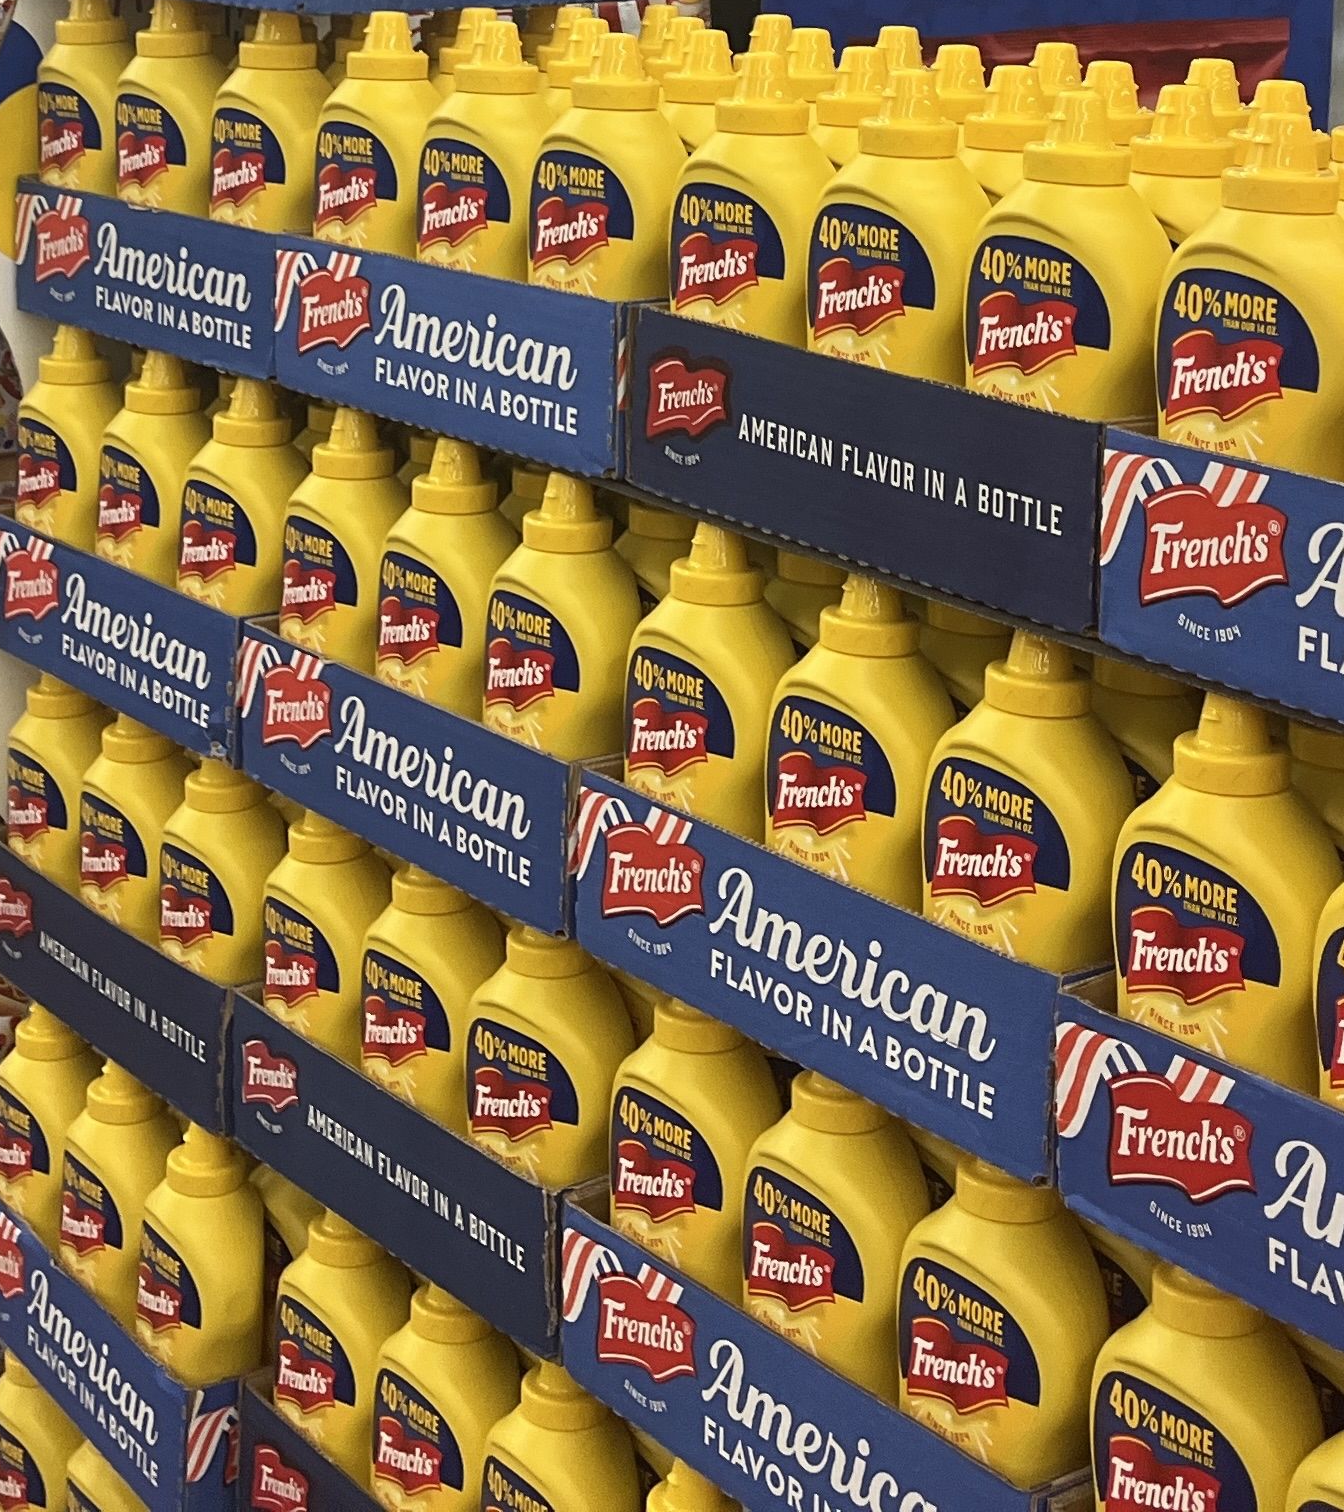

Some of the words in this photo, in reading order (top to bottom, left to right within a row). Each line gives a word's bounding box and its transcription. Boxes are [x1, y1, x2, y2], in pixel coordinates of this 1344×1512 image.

[981, 246, 1023, 283] 40%
[1024, 254, 1073, 287] MORE
[977, 312, 1065, 357] French's
[657, 379, 714, 411] French's
[738, 413, 834, 469] AMERICAN
[841, 443, 915, 492] FLAVOR
[922, 467, 947, 501] IN
[953, 477, 969, 508] A
[977, 482, 1064, 538] BOTTLE
[1150, 522, 1270, 573] French's
[1116, 1104, 1236, 1167] French's
